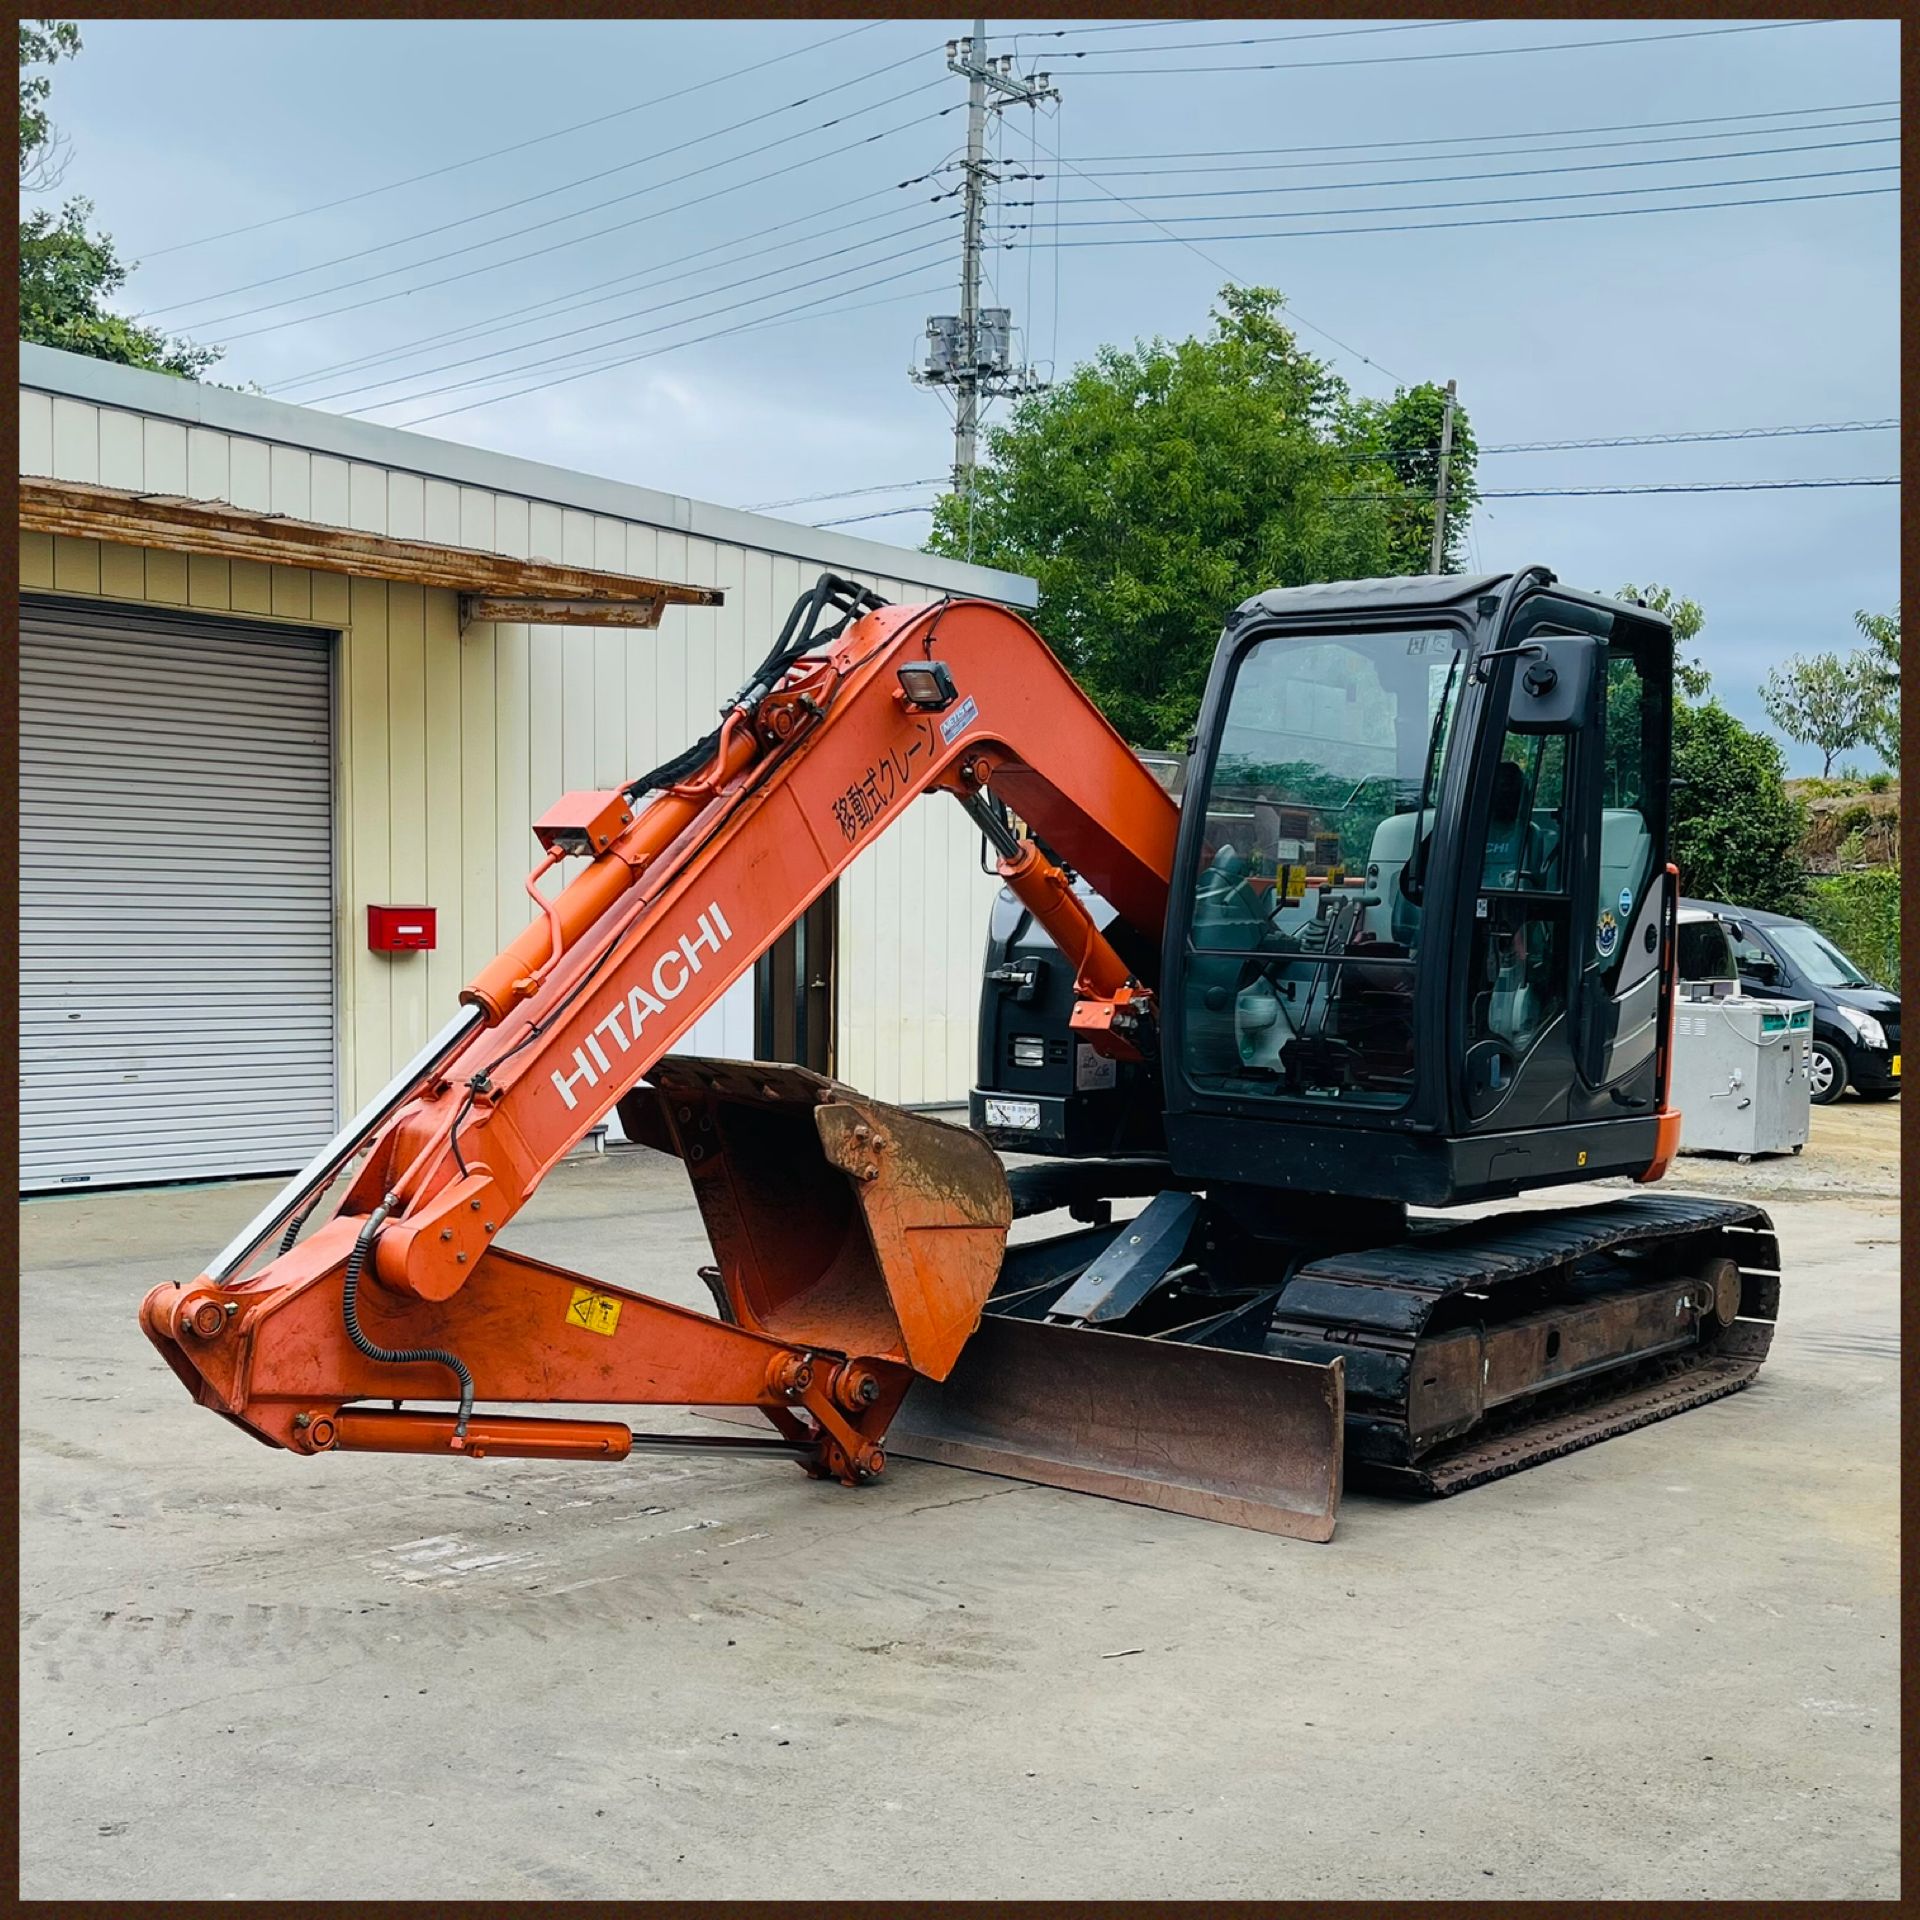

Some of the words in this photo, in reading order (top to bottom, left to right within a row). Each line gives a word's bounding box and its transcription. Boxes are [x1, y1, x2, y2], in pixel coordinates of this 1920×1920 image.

[832, 717, 935, 842] 移動式クレーン
[550, 901, 733, 1111] HITACHI
